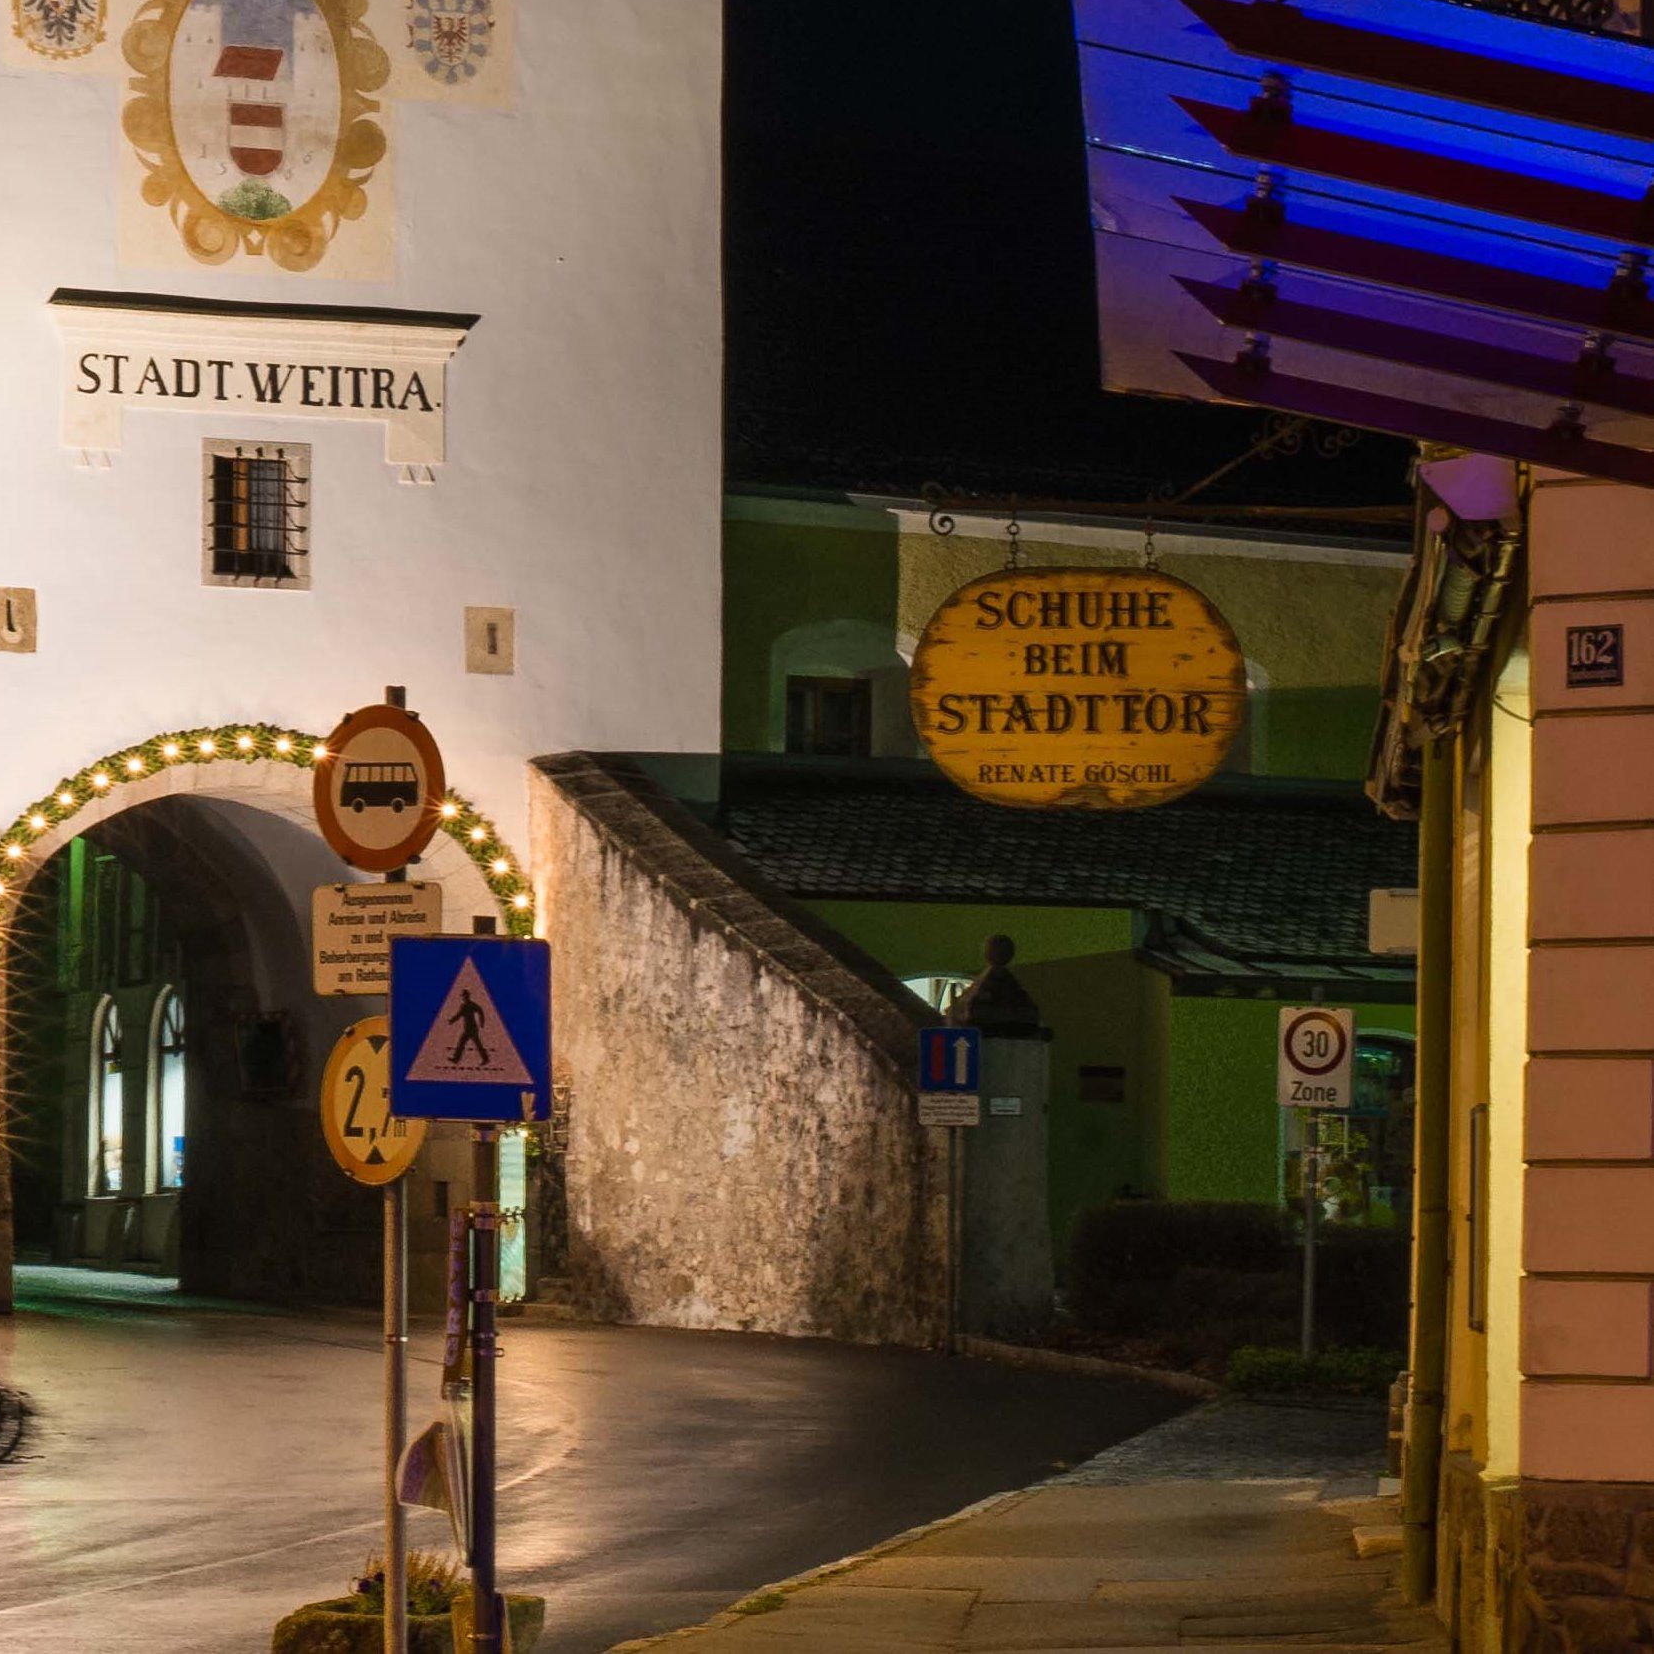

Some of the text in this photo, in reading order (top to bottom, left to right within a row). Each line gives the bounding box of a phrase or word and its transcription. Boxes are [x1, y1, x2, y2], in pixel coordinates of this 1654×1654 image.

[975, 591, 1175, 631] SCHUHE
[1024, 643, 1129, 677] BEIM
[1569, 631, 1614, 665] 162
[936, 693, 1214, 735] STADTTOR
[978, 761, 1177, 784] RENATE GÖSCHL
[1303, 1030, 1329, 1058] 30
[1291, 1081, 1337, 1102] Zone
